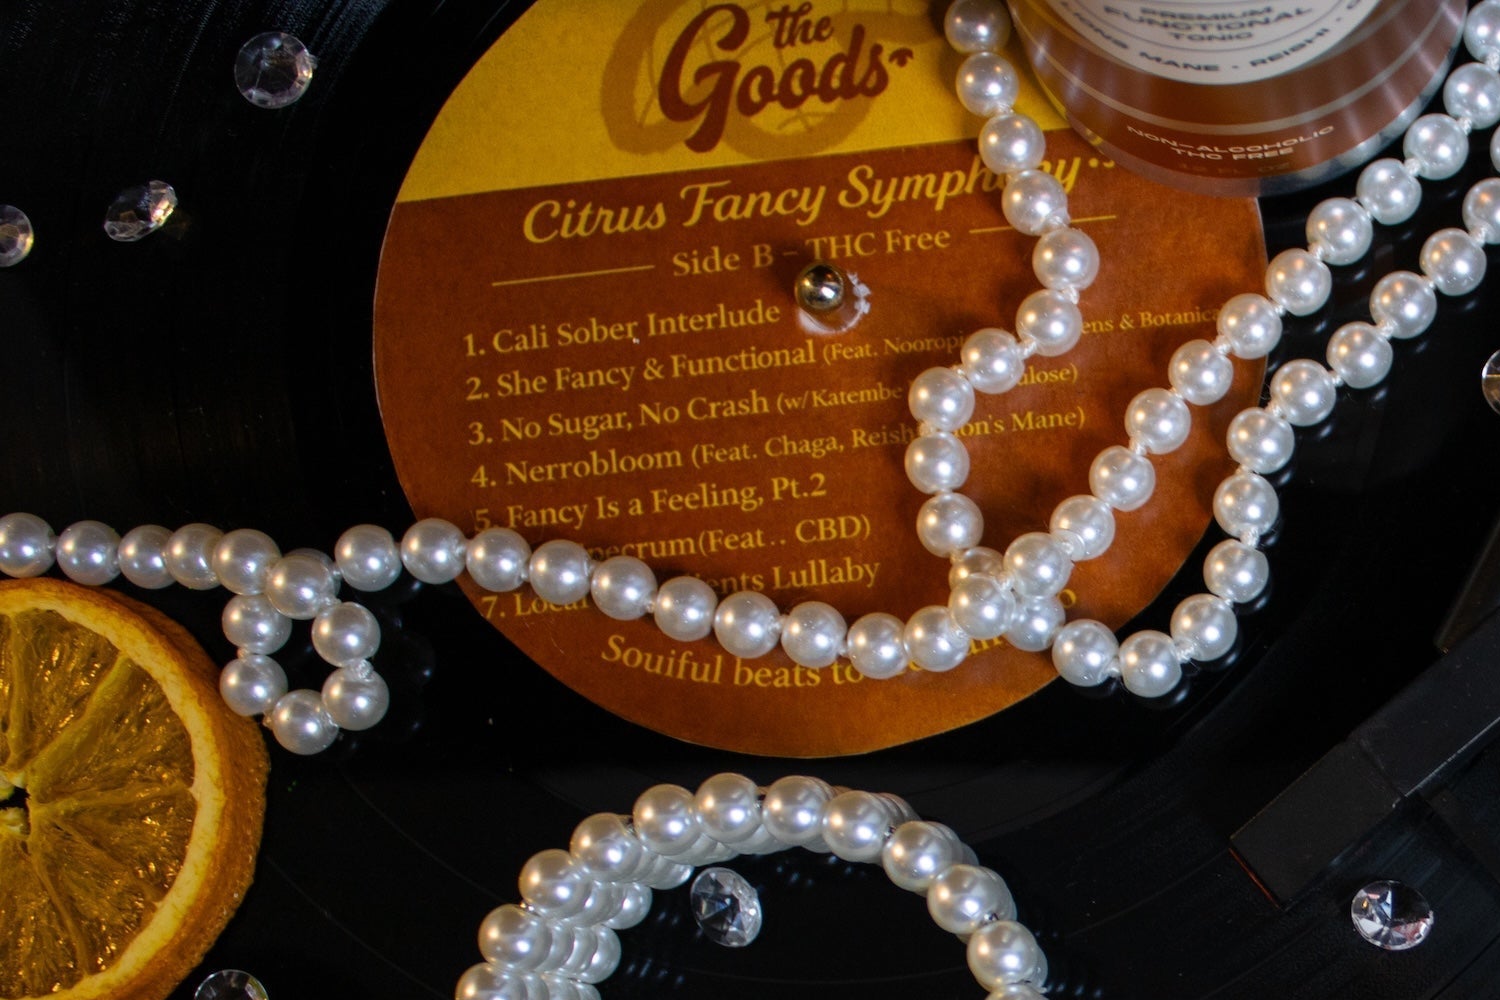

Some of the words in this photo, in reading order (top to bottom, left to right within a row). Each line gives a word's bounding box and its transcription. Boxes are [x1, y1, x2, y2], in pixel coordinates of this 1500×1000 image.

[766, 2, 834, 50] the
[1104, 5, 1313, 30] FUNCTIONAL
[1141, 5, 1272, 19] PREMIUM
[1169, 31, 1253, 41] TONIC
[1139, 51, 1220, 71] MANE
[1249, 28, 1330, 67] REISHI
[659, 3, 890, 153] Goods
[1126, 125, 1335, 153] NON-ALCOHOLIC
[1170, 146, 1223, 160] THC
[1232, 146, 1294, 160] FREE
[522, 199, 667, 244] Citrus
[679, 180, 827, 226] Fancy
[838, 154, 1082, 219] Symphy
[672, 246, 741, 277] Side
[753, 242, 774, 268] B
[804, 231, 876, 261] THC
[885, 227, 952, 254] Free
[463, 332, 486, 358] 1.
[492, 323, 550, 354] Cali
[556, 316, 640, 347] Sober
[646, 299, 782, 337] Interlude
[465, 376, 491, 400] 2.
[497, 369, 548, 398] She
[553, 365, 637, 392] Fancy
[643, 357, 665, 381] &
[670, 338, 816, 379] Functional
[822, 343, 879, 366] (Feat.
[1119, 313, 1137, 331] &
[1139, 307, 1220, 329] Botanica
[468, 420, 494, 446] 3.
[500, 416, 542, 442] No
[548, 410, 633, 442] Sugar,
[638, 401, 681, 427] No
[686, 388, 771, 422] Crash
[470, 464, 498, 489] 4.
[504, 448, 683, 485] Nerrobloom
[690, 443, 758, 470] (Feat.
[764, 433, 845, 459] Chaga,
[852, 422, 914, 447] Reish
[1010, 405, 1086, 431] Mane)
[506, 504, 589, 530] Fancy
[595, 495, 620, 520] Is
[628, 498, 644, 516] a
[650, 482, 765, 513] Feeling,
[771, 472, 828, 500] Pt.2
[794, 514, 872, 544] CBD)
[481, 595, 506, 620] 7.
[771, 556, 881, 590] Lullaby
[733, 657, 822, 689] beats
[830, 661, 865, 685] to
